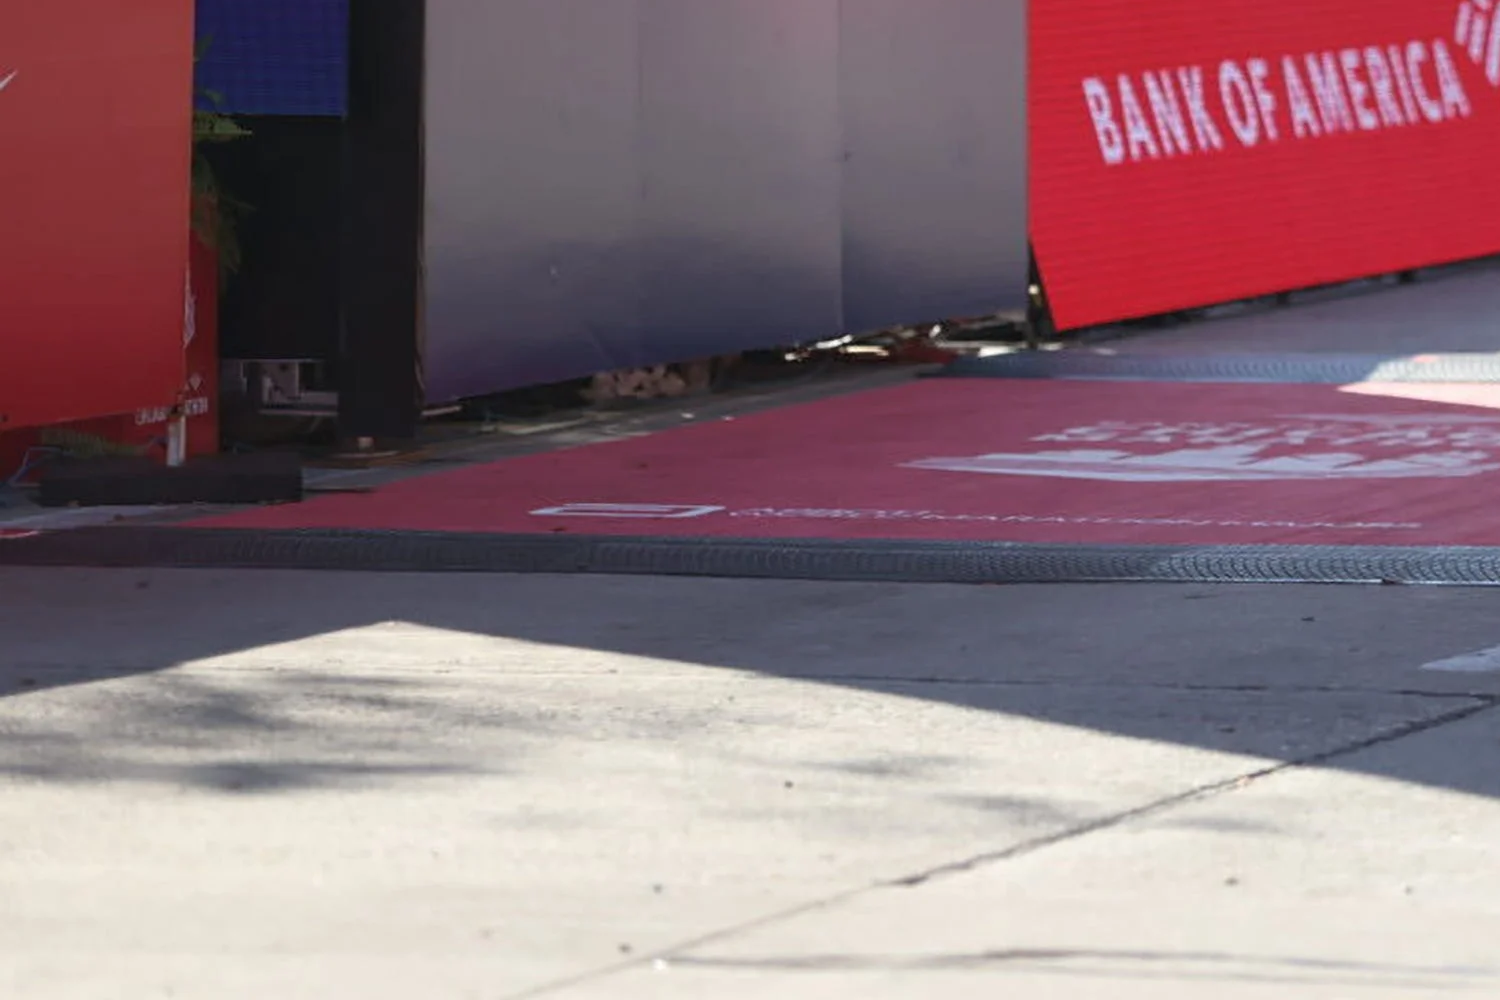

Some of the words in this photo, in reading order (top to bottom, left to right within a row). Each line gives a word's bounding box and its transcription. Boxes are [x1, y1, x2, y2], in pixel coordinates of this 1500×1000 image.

[1083, 67, 1224, 165] BANK
[1218, 57, 1279, 147] OF
[1283, 39, 1470, 138] AMERICA
